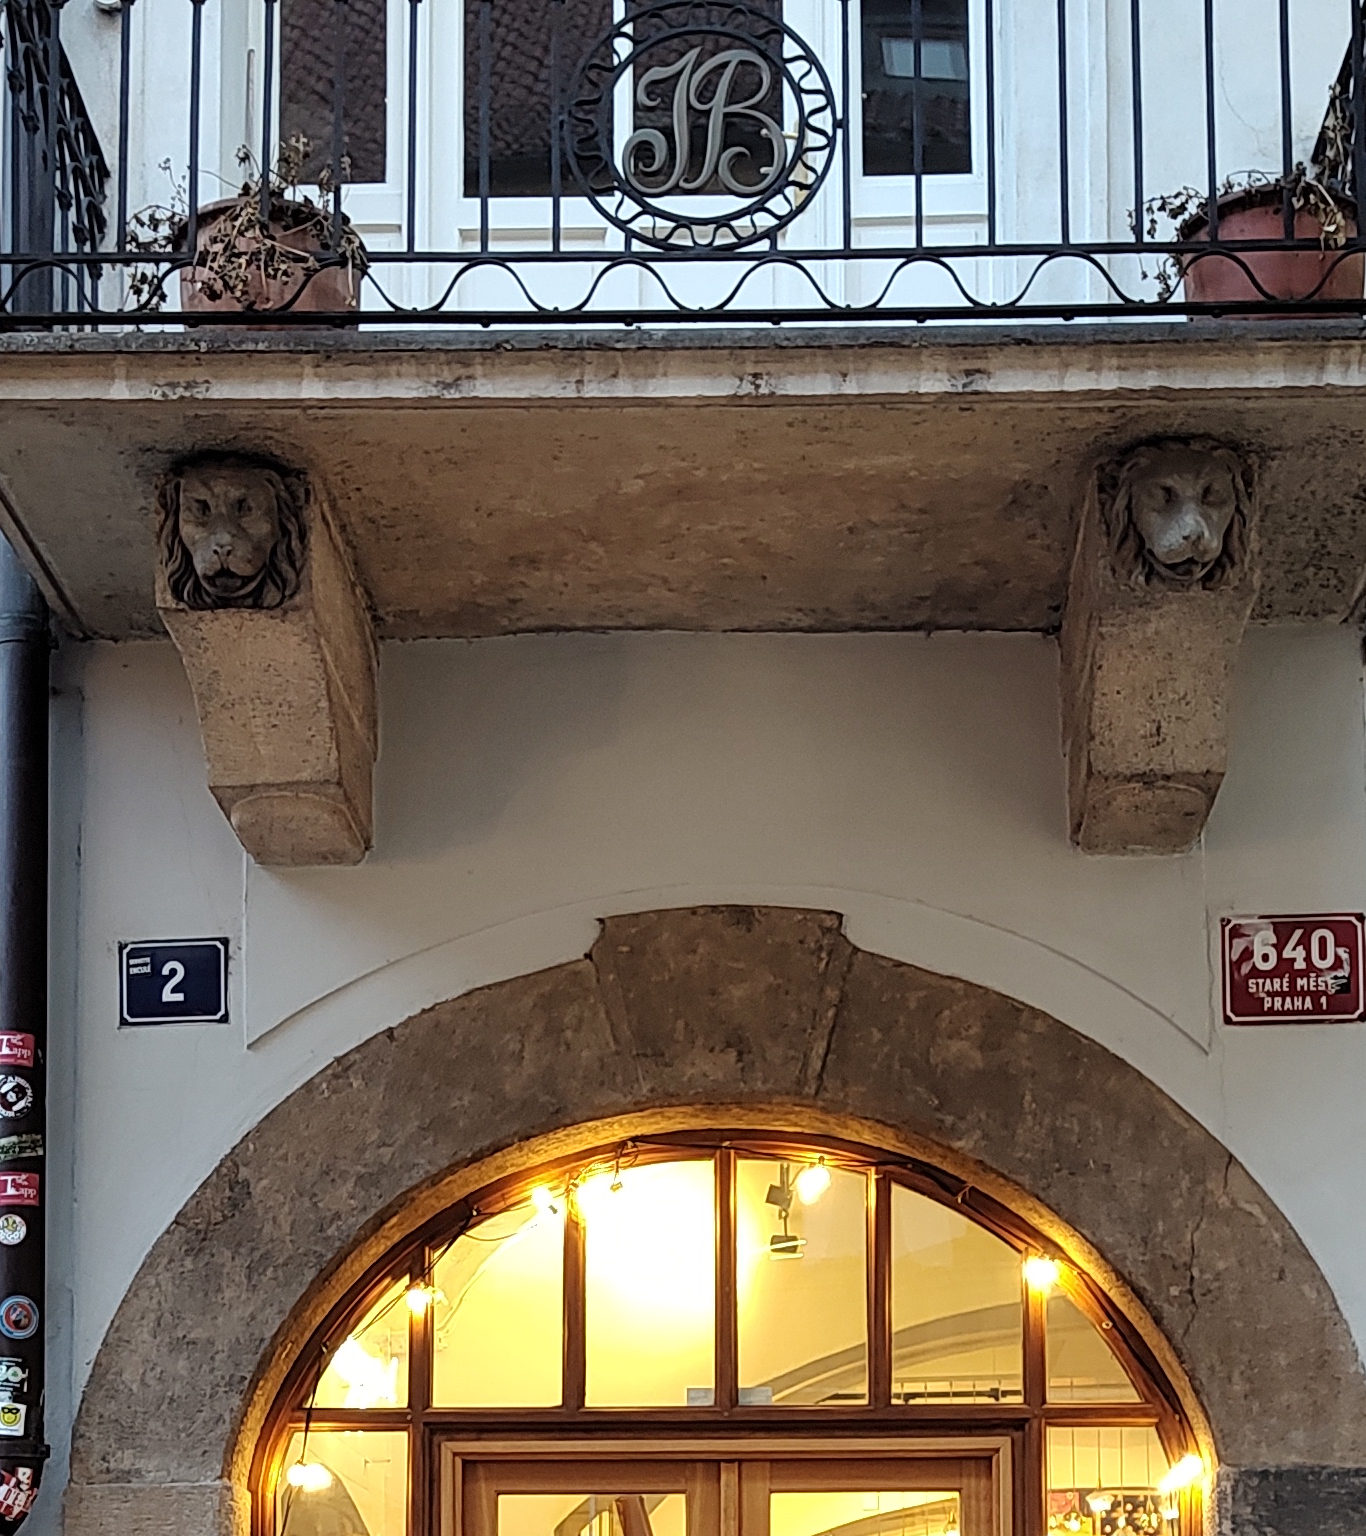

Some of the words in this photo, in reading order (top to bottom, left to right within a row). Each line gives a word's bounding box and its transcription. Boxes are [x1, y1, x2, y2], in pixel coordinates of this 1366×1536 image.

[1253, 928, 1335, 971] 640
[162, 960, 185, 1002] 2
[1248, 973, 1290, 993] STARÉ
[1296, 973, 1336, 993] MĚST
[1264, 996, 1313, 1011] PRAHA
[1320, 995, 1327, 1010] 1
